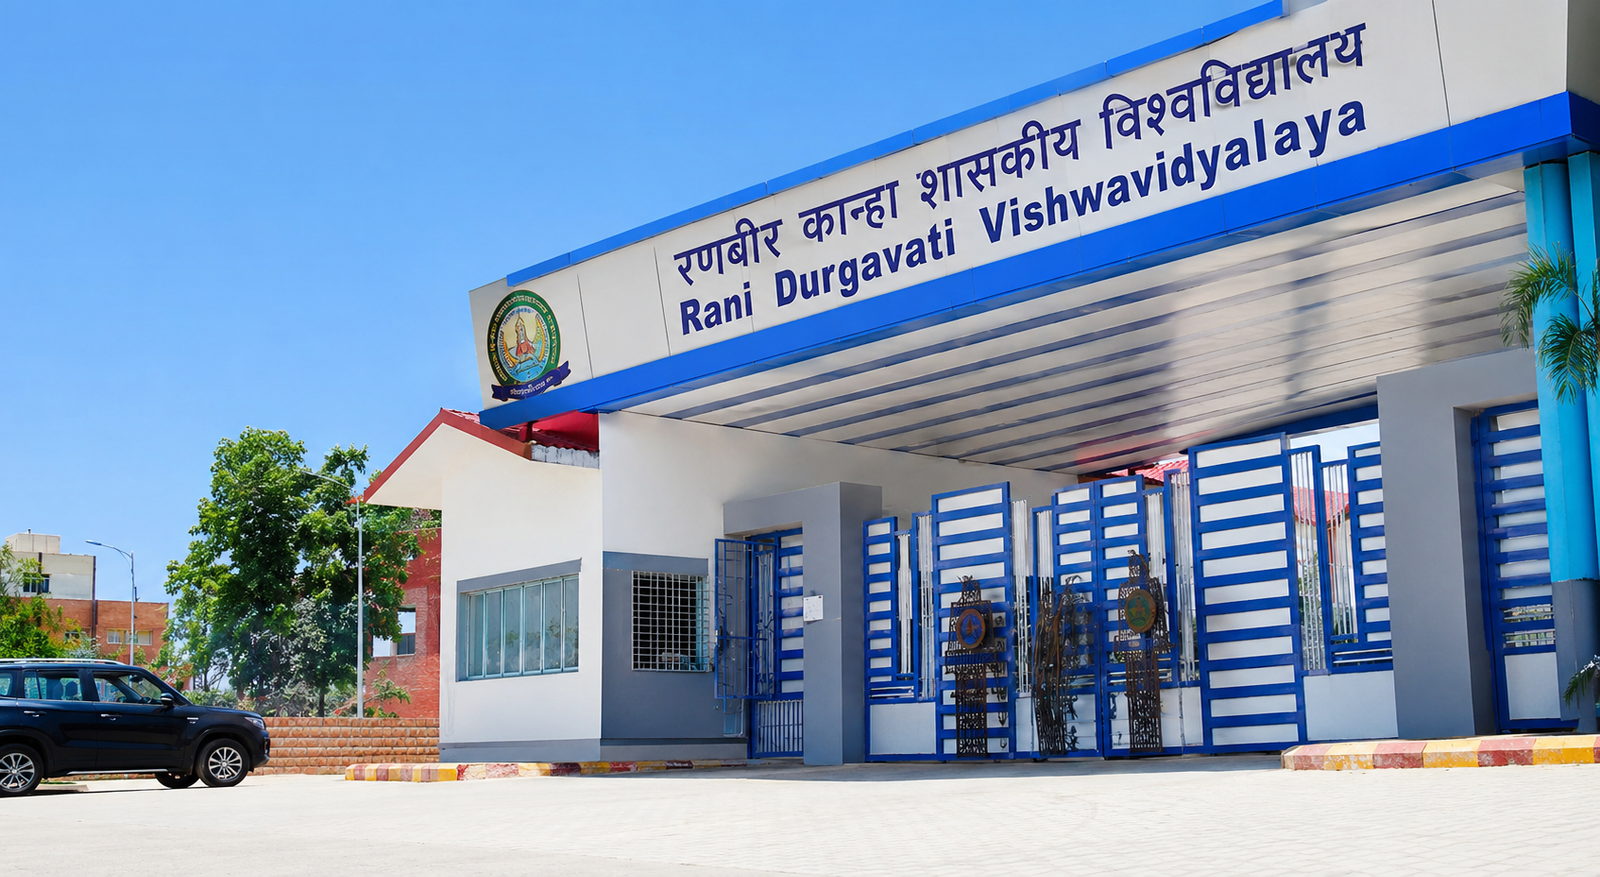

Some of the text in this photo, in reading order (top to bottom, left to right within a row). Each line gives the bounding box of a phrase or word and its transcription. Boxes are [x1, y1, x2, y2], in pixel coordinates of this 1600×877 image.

[673, 22, 1367, 286] रणबीर कान्हा शासकीय विश्वविद्यालय
[680, 99, 1367, 336] Rani Durgavati Vishwavidyalaya
